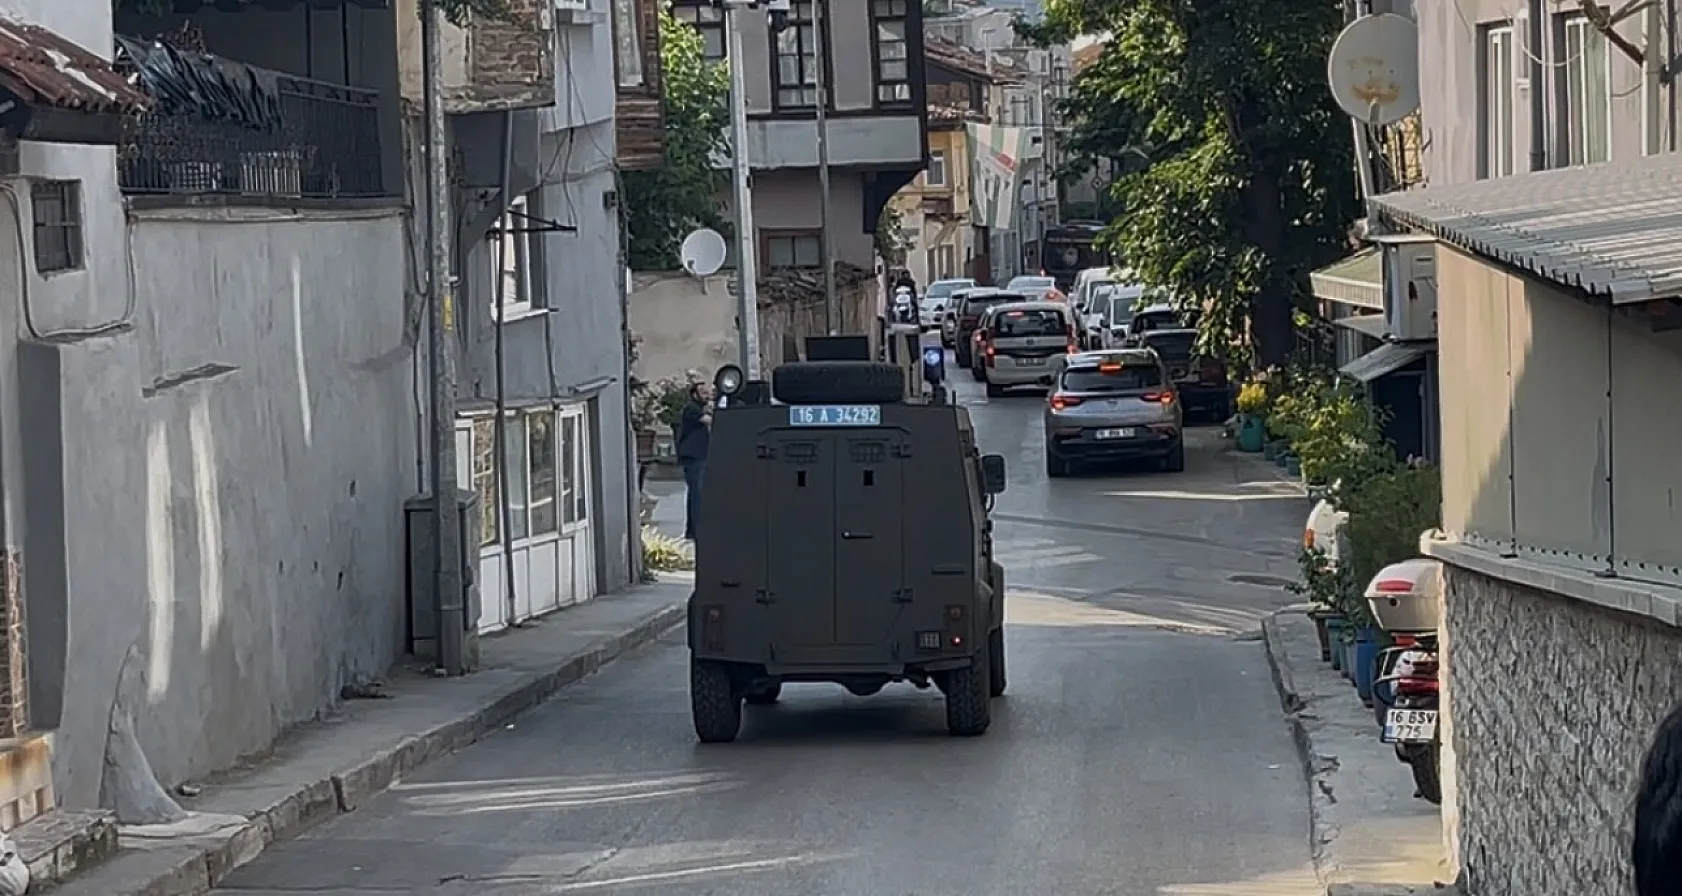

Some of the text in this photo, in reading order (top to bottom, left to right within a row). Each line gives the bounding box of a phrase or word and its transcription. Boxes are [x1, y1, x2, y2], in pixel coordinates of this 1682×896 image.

[799, 406, 877, 423] 16 A 34292
[1390, 711, 1404, 723] 16
[1396, 725, 1422, 737] 775
